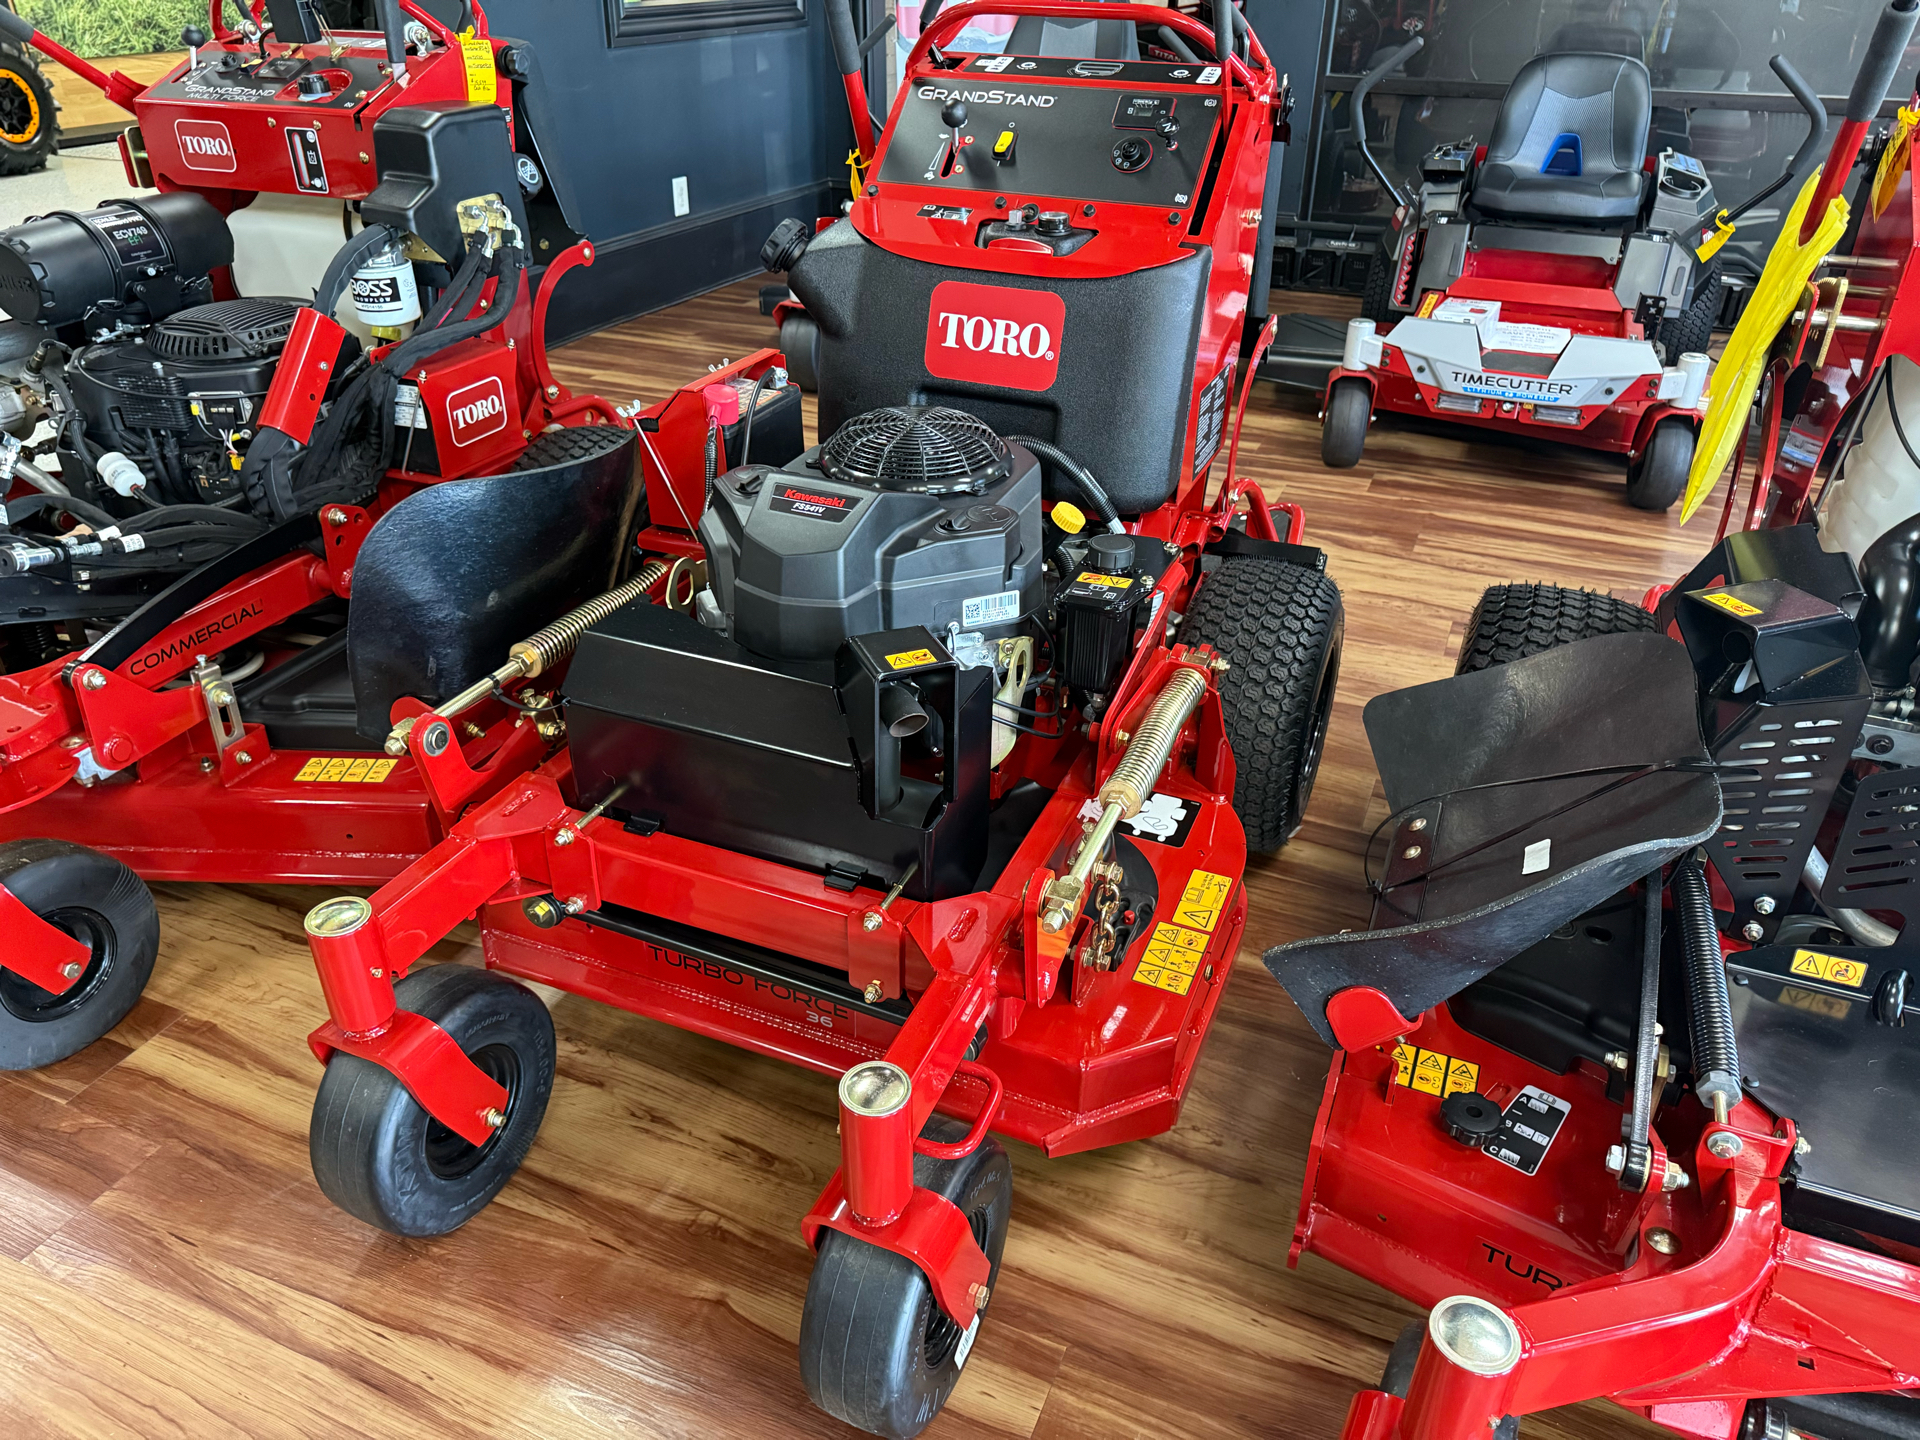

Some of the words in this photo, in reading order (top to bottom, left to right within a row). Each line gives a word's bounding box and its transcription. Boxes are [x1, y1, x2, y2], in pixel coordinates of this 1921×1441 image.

[1154, 49, 1181, 63] TITAN
[187, 92, 221, 101] MULTI
[222, 94, 260, 103] FORCE
[182, 135, 229, 156] TORO
[112, 226, 148, 240] ECV749
[127, 235, 144, 246] EFI
[350, 279, 393, 297] BOSS
[939, 312, 1051, 358] TORO
[1451, 371, 1573, 395] TIMECUTTER
[1467, 387, 1503, 396] LITHIUM
[1516, 391, 1555, 402] POWERED
[453, 395, 501, 429] TORO
[784, 488, 846, 508] Kawasaki
[792, 502, 826, 513] FS541V
[130, 603, 263, 675] COMMERCIAL
[648, 945, 744, 986] TURBO
[754, 977, 849, 1020] FORCE
[805, 1010, 833, 1028] 36
[1518, 1096, 1528, 1104] A
[1489, 1145, 1499, 1154] C
[1482, 1242, 1573, 1292] TUR
